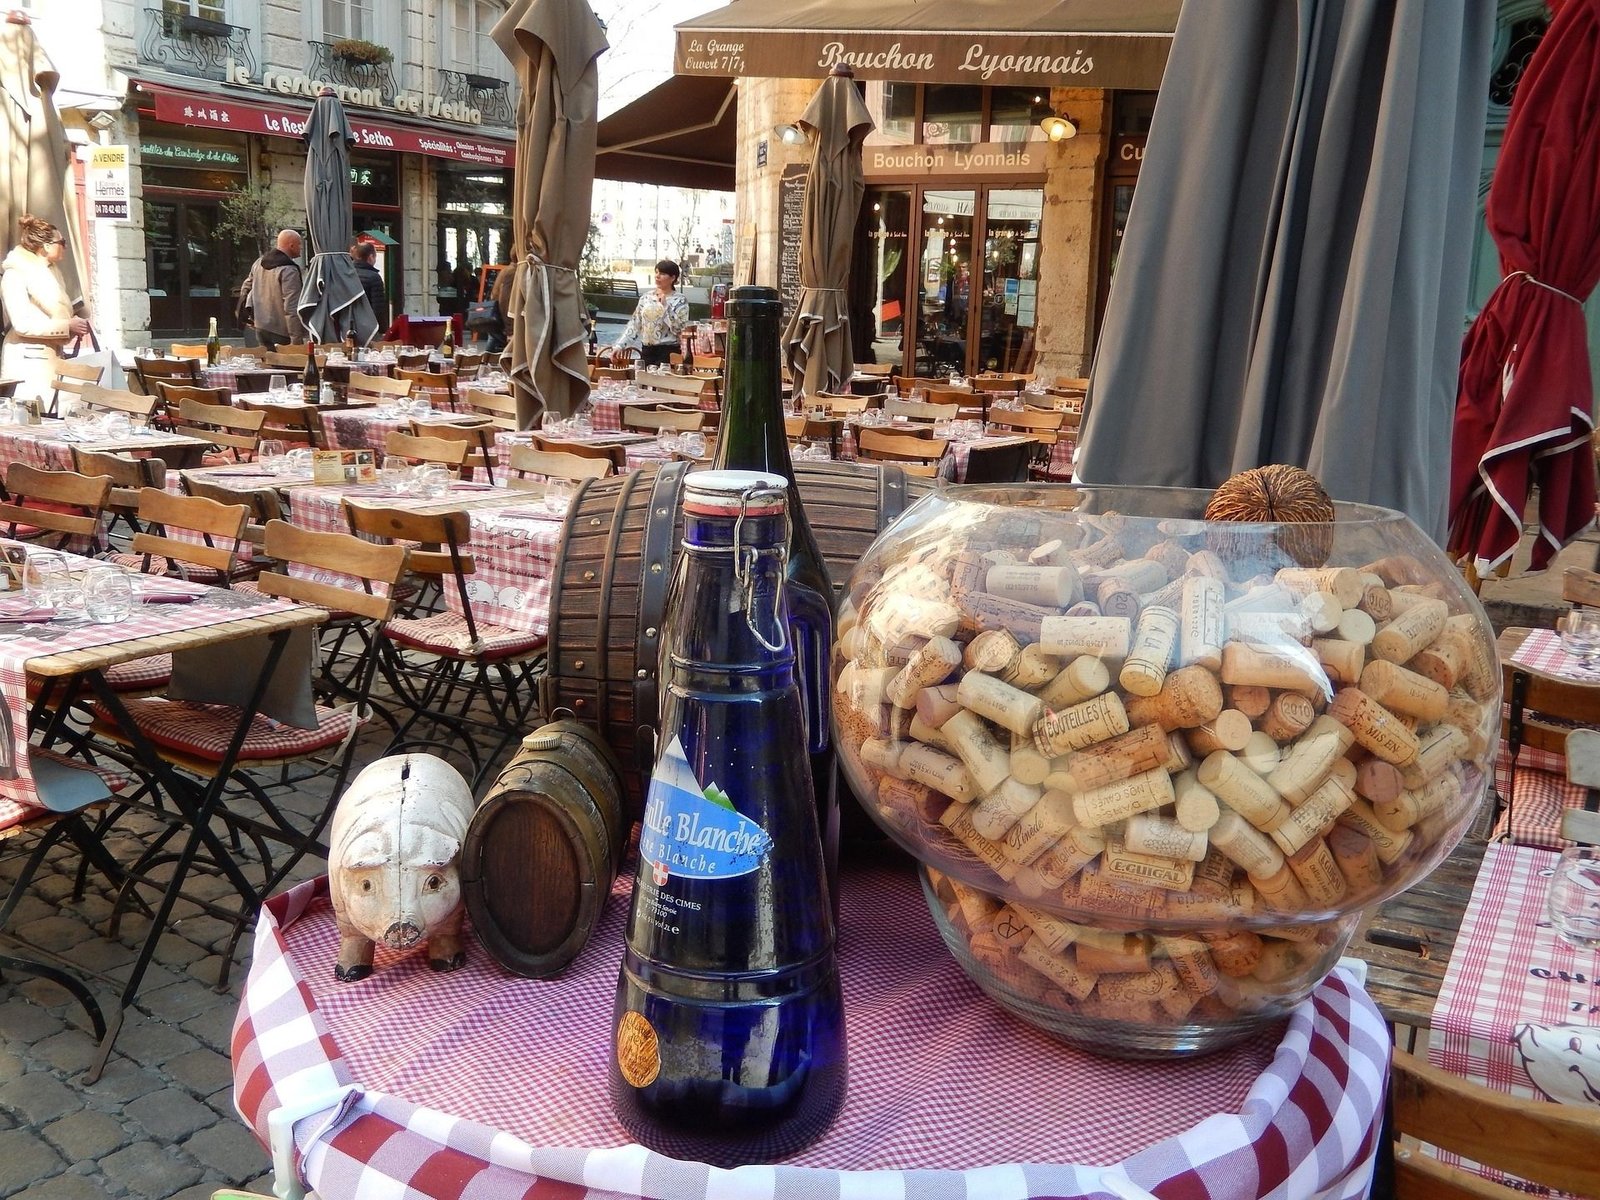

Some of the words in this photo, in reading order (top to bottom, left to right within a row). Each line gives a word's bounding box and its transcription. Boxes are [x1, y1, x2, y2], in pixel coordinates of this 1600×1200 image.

[688, 39, 703, 52] La
[707, 39, 745, 56] Grange
[817, 41, 935, 70] Bouchon
[958, 43, 1095, 80] Lyonnais
[685, 56, 718, 70] Ouvert
[226, 57, 249, 84] le
[430, 96, 482, 125] Setha
[264, 113, 280, 131] Le
[362, 129, 394, 147] Setha
[98, 153, 125, 163] VENDRE
[873, 152, 944, 169] Bouchon
[954, 150, 1031, 171] Lyonnais
[1046, 702, 1100, 738] BOUTEILLES
[1283, 702, 1311, 717] 2010
[1365, 725, 1385, 743] MIS
[1383, 738, 1401, 754] EN
[674, 811, 761, 855] Blanche
[958, 818, 1004, 864] PROPRIETE
[658, 843, 717, 874] Blanche
[1114, 861, 1182, 882] E.GUIGAL
[660, 891, 675, 903] DES
[675, 898, 702, 911] CIMES
